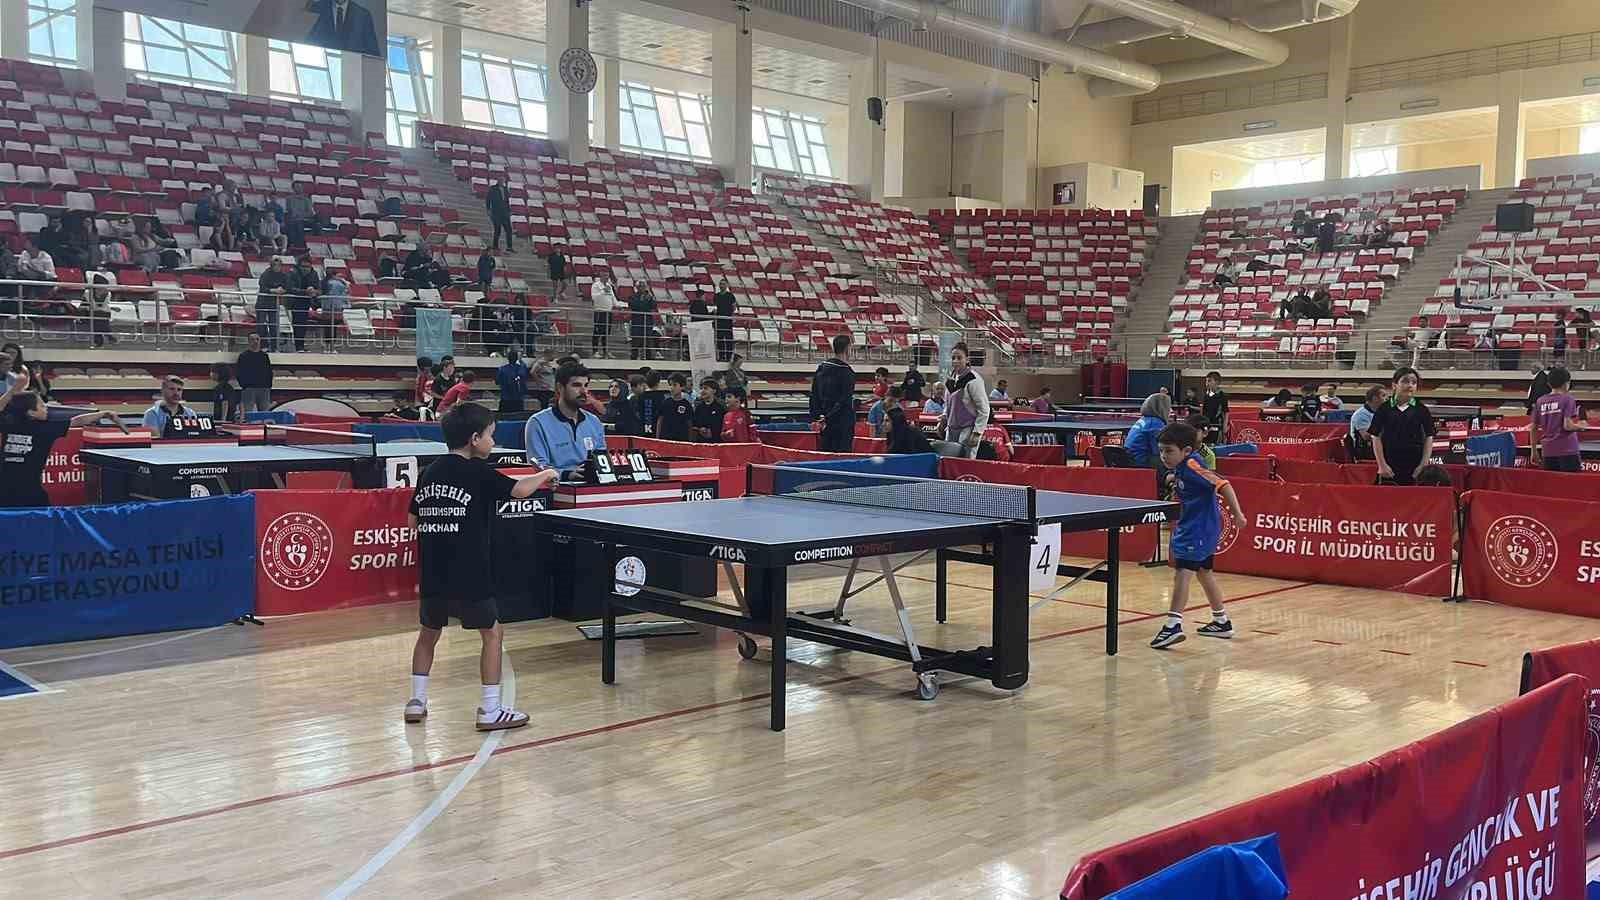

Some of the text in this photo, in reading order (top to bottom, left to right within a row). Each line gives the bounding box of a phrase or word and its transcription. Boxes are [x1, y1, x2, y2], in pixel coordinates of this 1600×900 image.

[173, 418, 183, 431] 9
[198, 417, 212, 430] 10
[498, 456, 523, 464] STIGA
[597, 454, 611, 473] 9
[627, 453, 647, 472] 10
[178, 467, 228, 475] COMPETITION
[395, 462, 411, 488] 5
[498, 500, 545, 513] STIGA
[1141, 512, 1167, 524] STIGA
[1255, 513, 1436, 540] ESKİŞEHİR GENÇLİK VE
[60, 547, 141, 573] MASA
[147, 532, 225, 566] TENİSİ
[709, 545, 747, 561] STIGA
[794, 545, 853, 561] COMPETITION
[1253, 535, 1435, 562] SPOR İL MÜDÜRLÜĞÜ
[350, 547, 416, 571] SPOR İL
[1036, 544, 1050, 574] 4
[1526, 785, 1560, 832] VE
